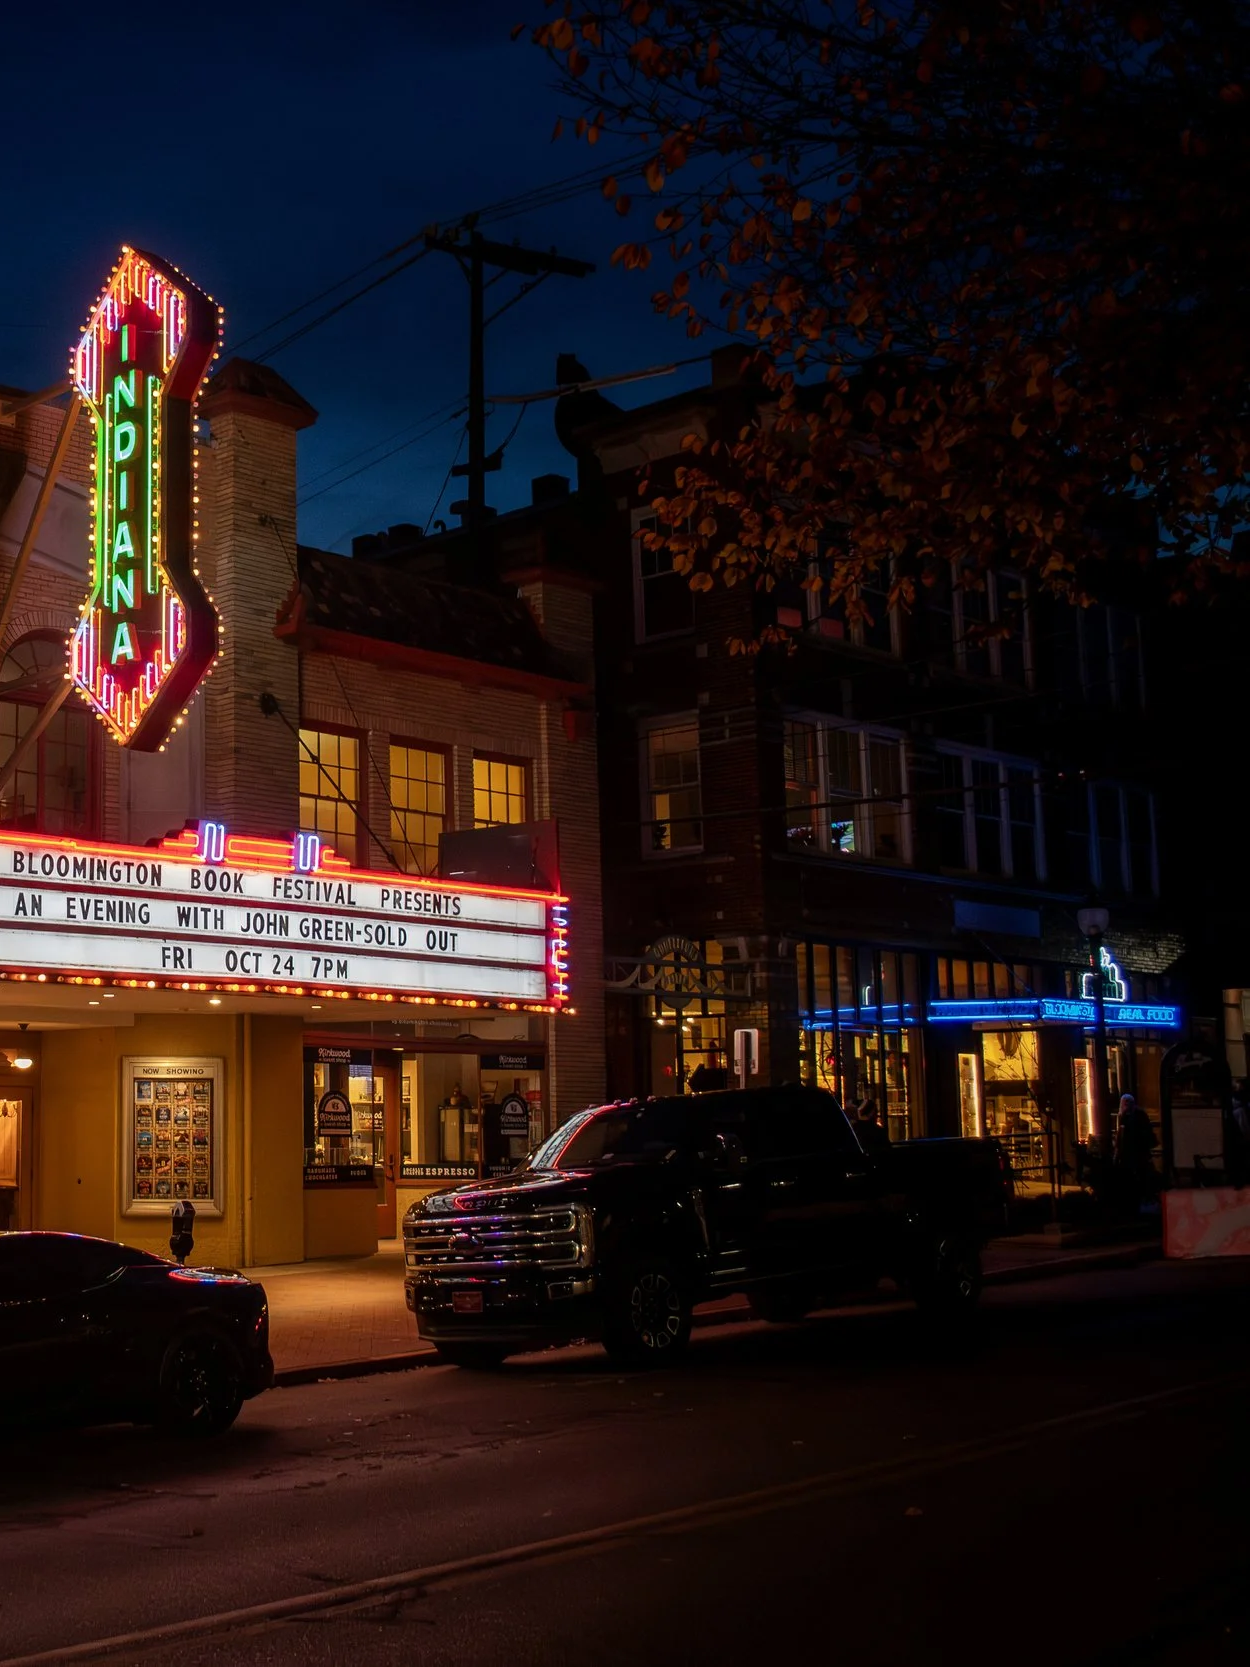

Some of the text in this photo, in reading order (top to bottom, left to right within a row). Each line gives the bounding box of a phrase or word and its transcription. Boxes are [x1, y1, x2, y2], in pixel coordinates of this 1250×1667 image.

[111, 324, 141, 665] INDIANA
[13, 850, 461, 916] BLOOMINGTON BOOK FESTIVAL PRESENTS
[14, 892, 459, 952] AN EVENING WITH JOHN GREEN-SOLD OUT
[161, 945, 349, 980] FRI OCT 24 7PM
[1146, 1009, 1174, 1020] FOOD
[425, 1167, 476, 1176] ESPRESSO
